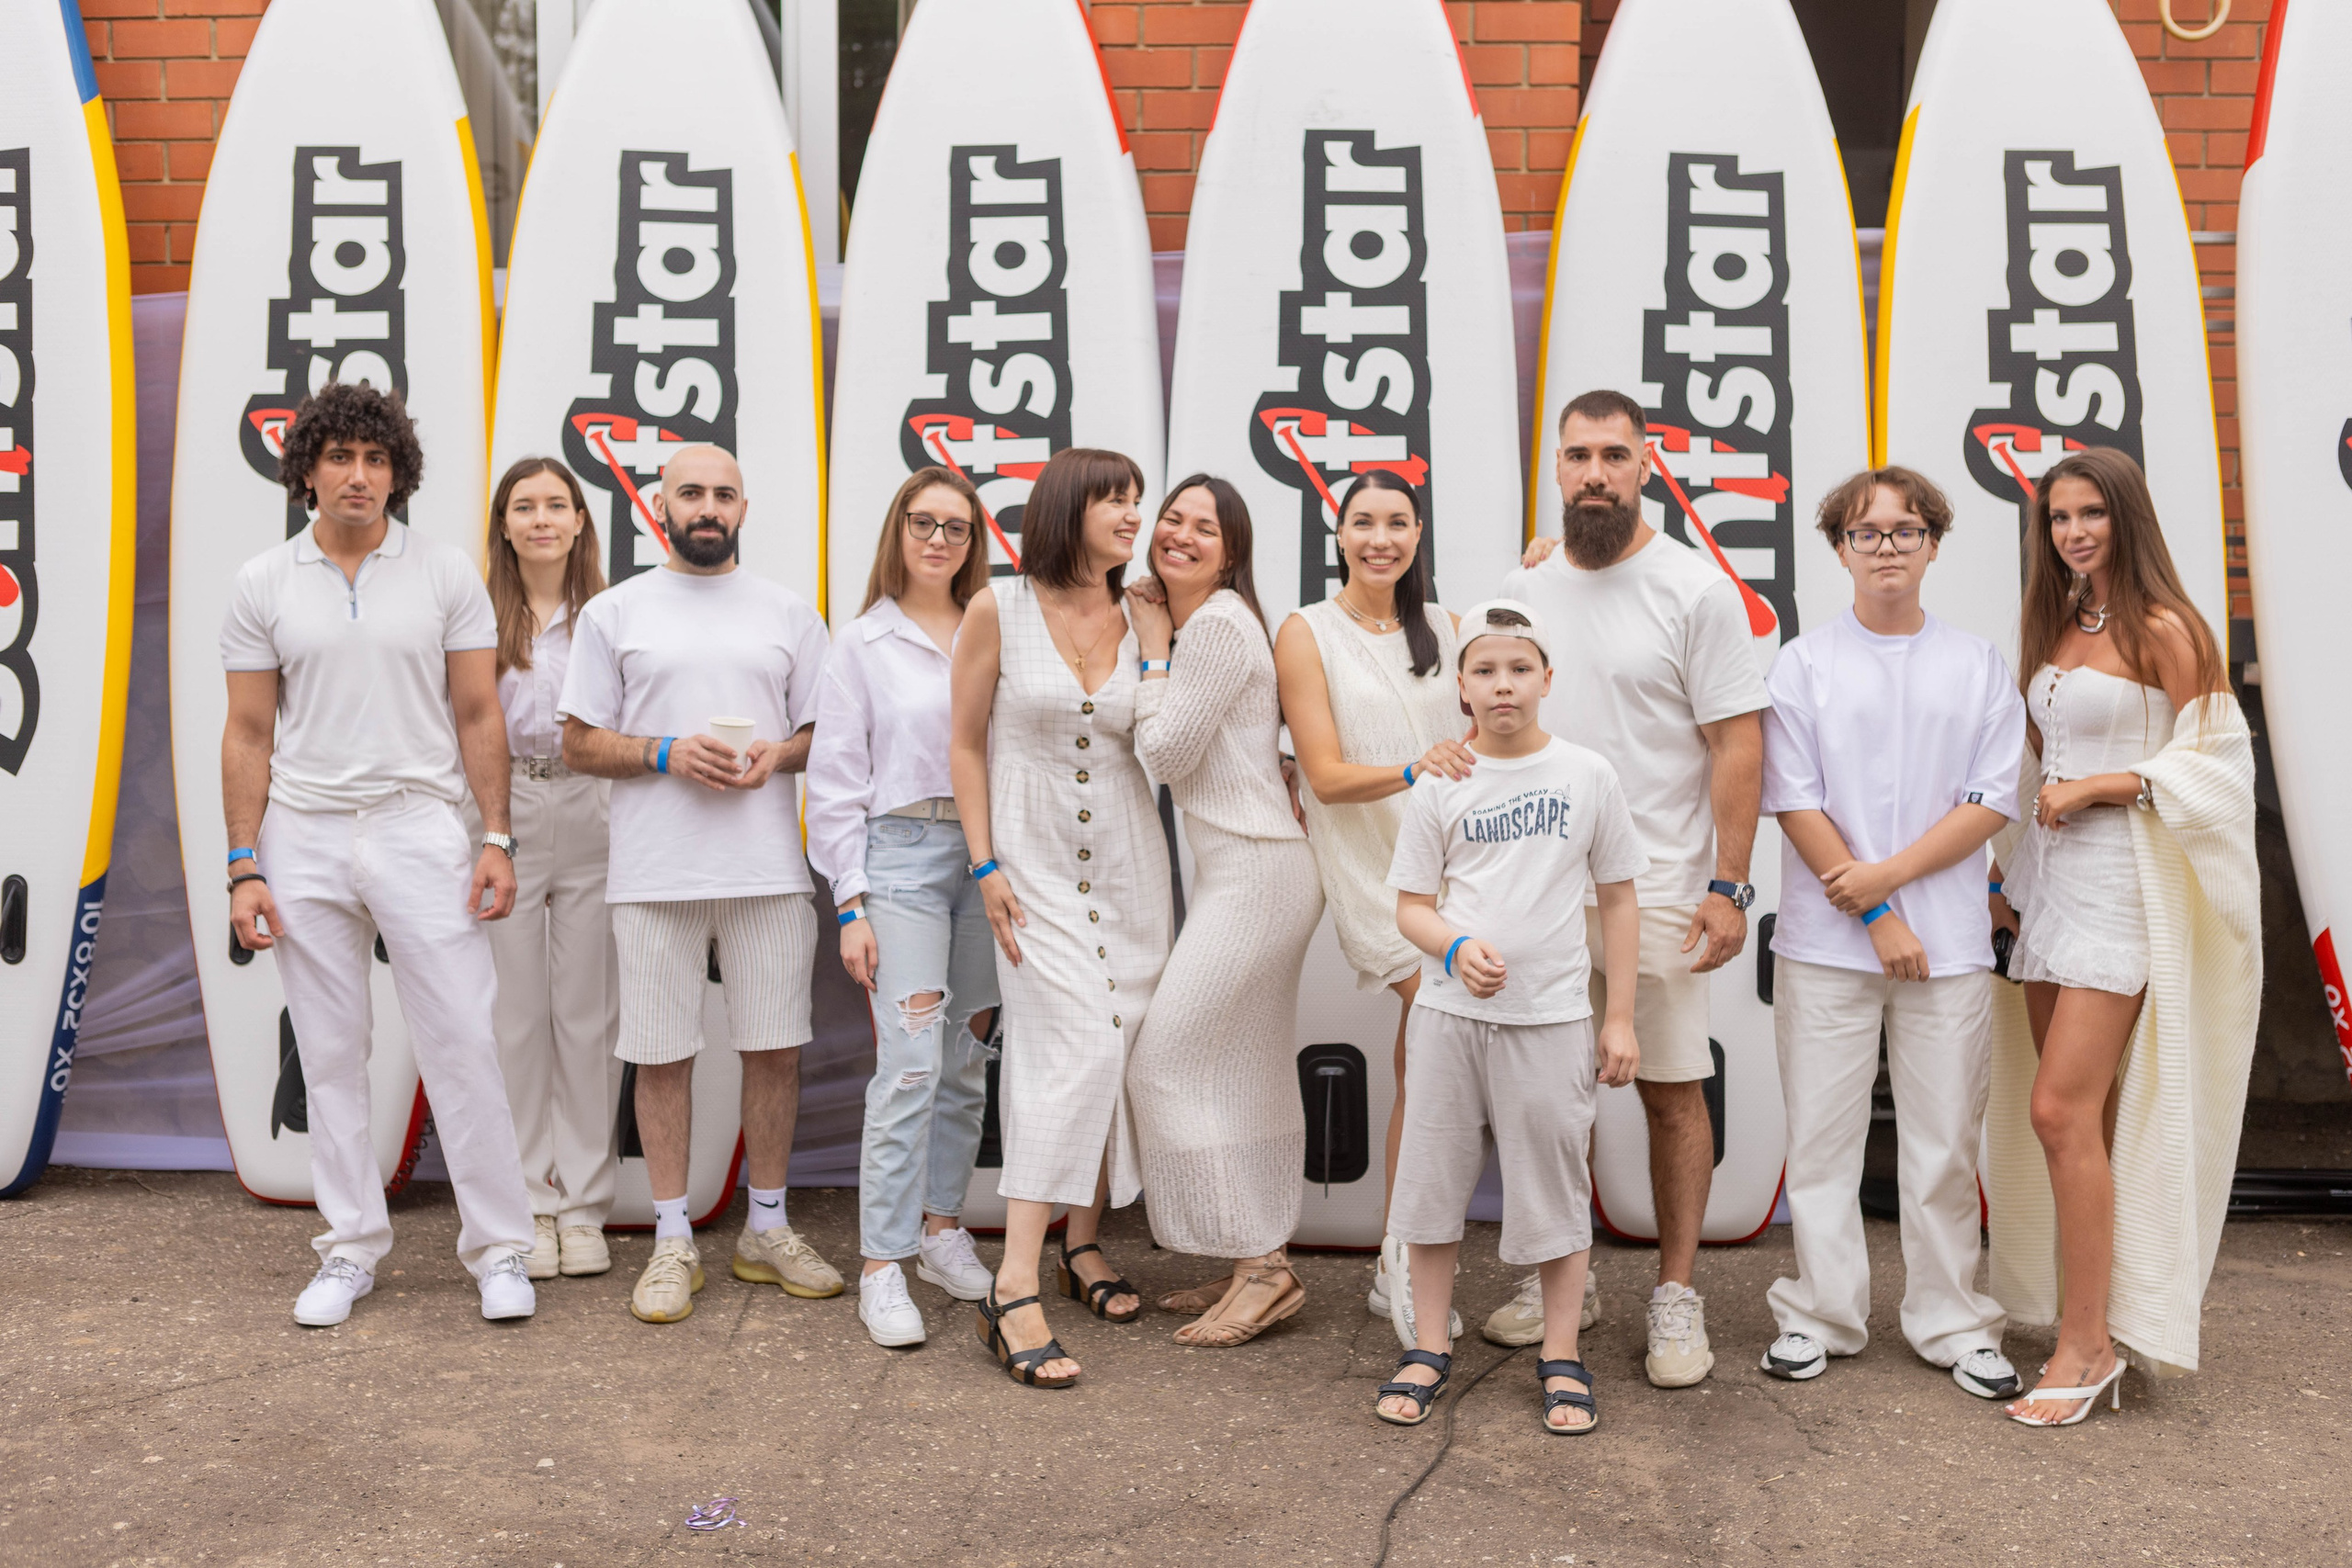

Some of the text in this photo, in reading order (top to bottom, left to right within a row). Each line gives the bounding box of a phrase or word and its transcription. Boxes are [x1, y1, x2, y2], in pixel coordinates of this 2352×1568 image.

[1463, 797, 1570, 843] LANDSCAPE
[1472, 788, 1549, 816] ROAMING THE VACAY
